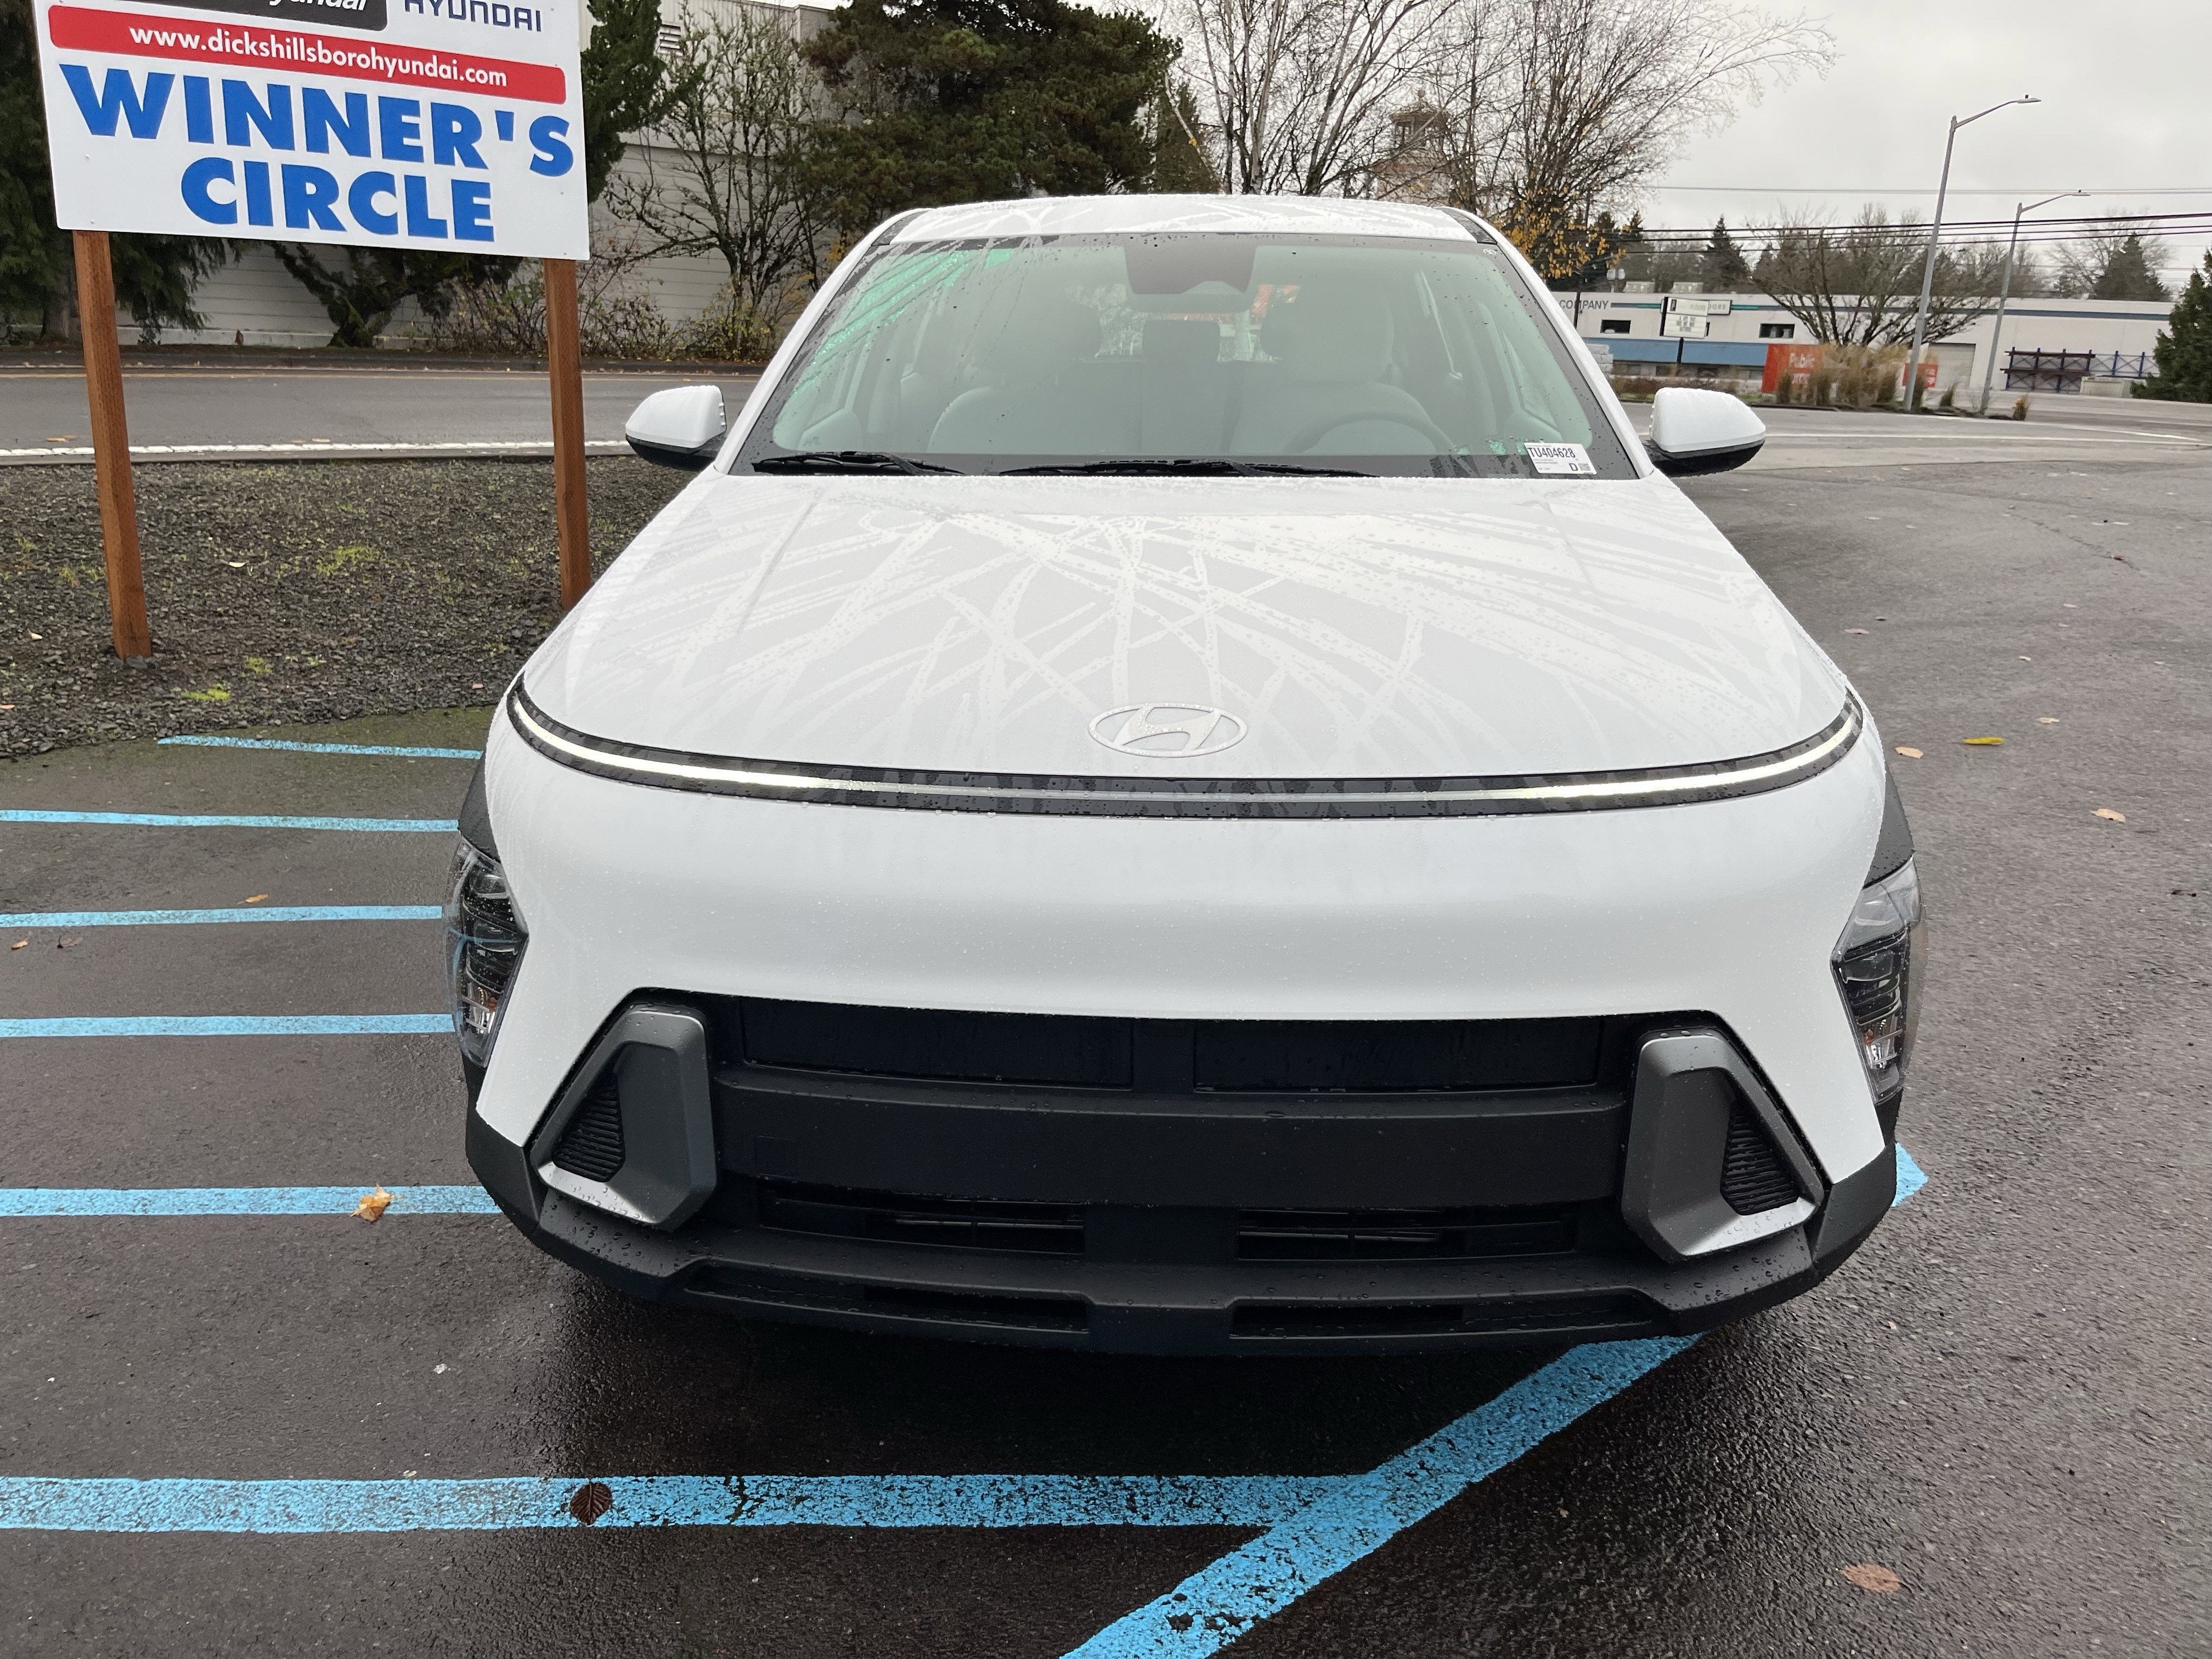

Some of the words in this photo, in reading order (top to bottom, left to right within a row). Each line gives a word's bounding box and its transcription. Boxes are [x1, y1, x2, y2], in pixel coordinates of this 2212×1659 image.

[129, 27, 507, 87] www.dickshillsborohyundai.com
[60, 64, 574, 177] WINNER'S
[181, 157, 495, 242] CIRCLE
[1527, 447, 1576, 458] TU404628
